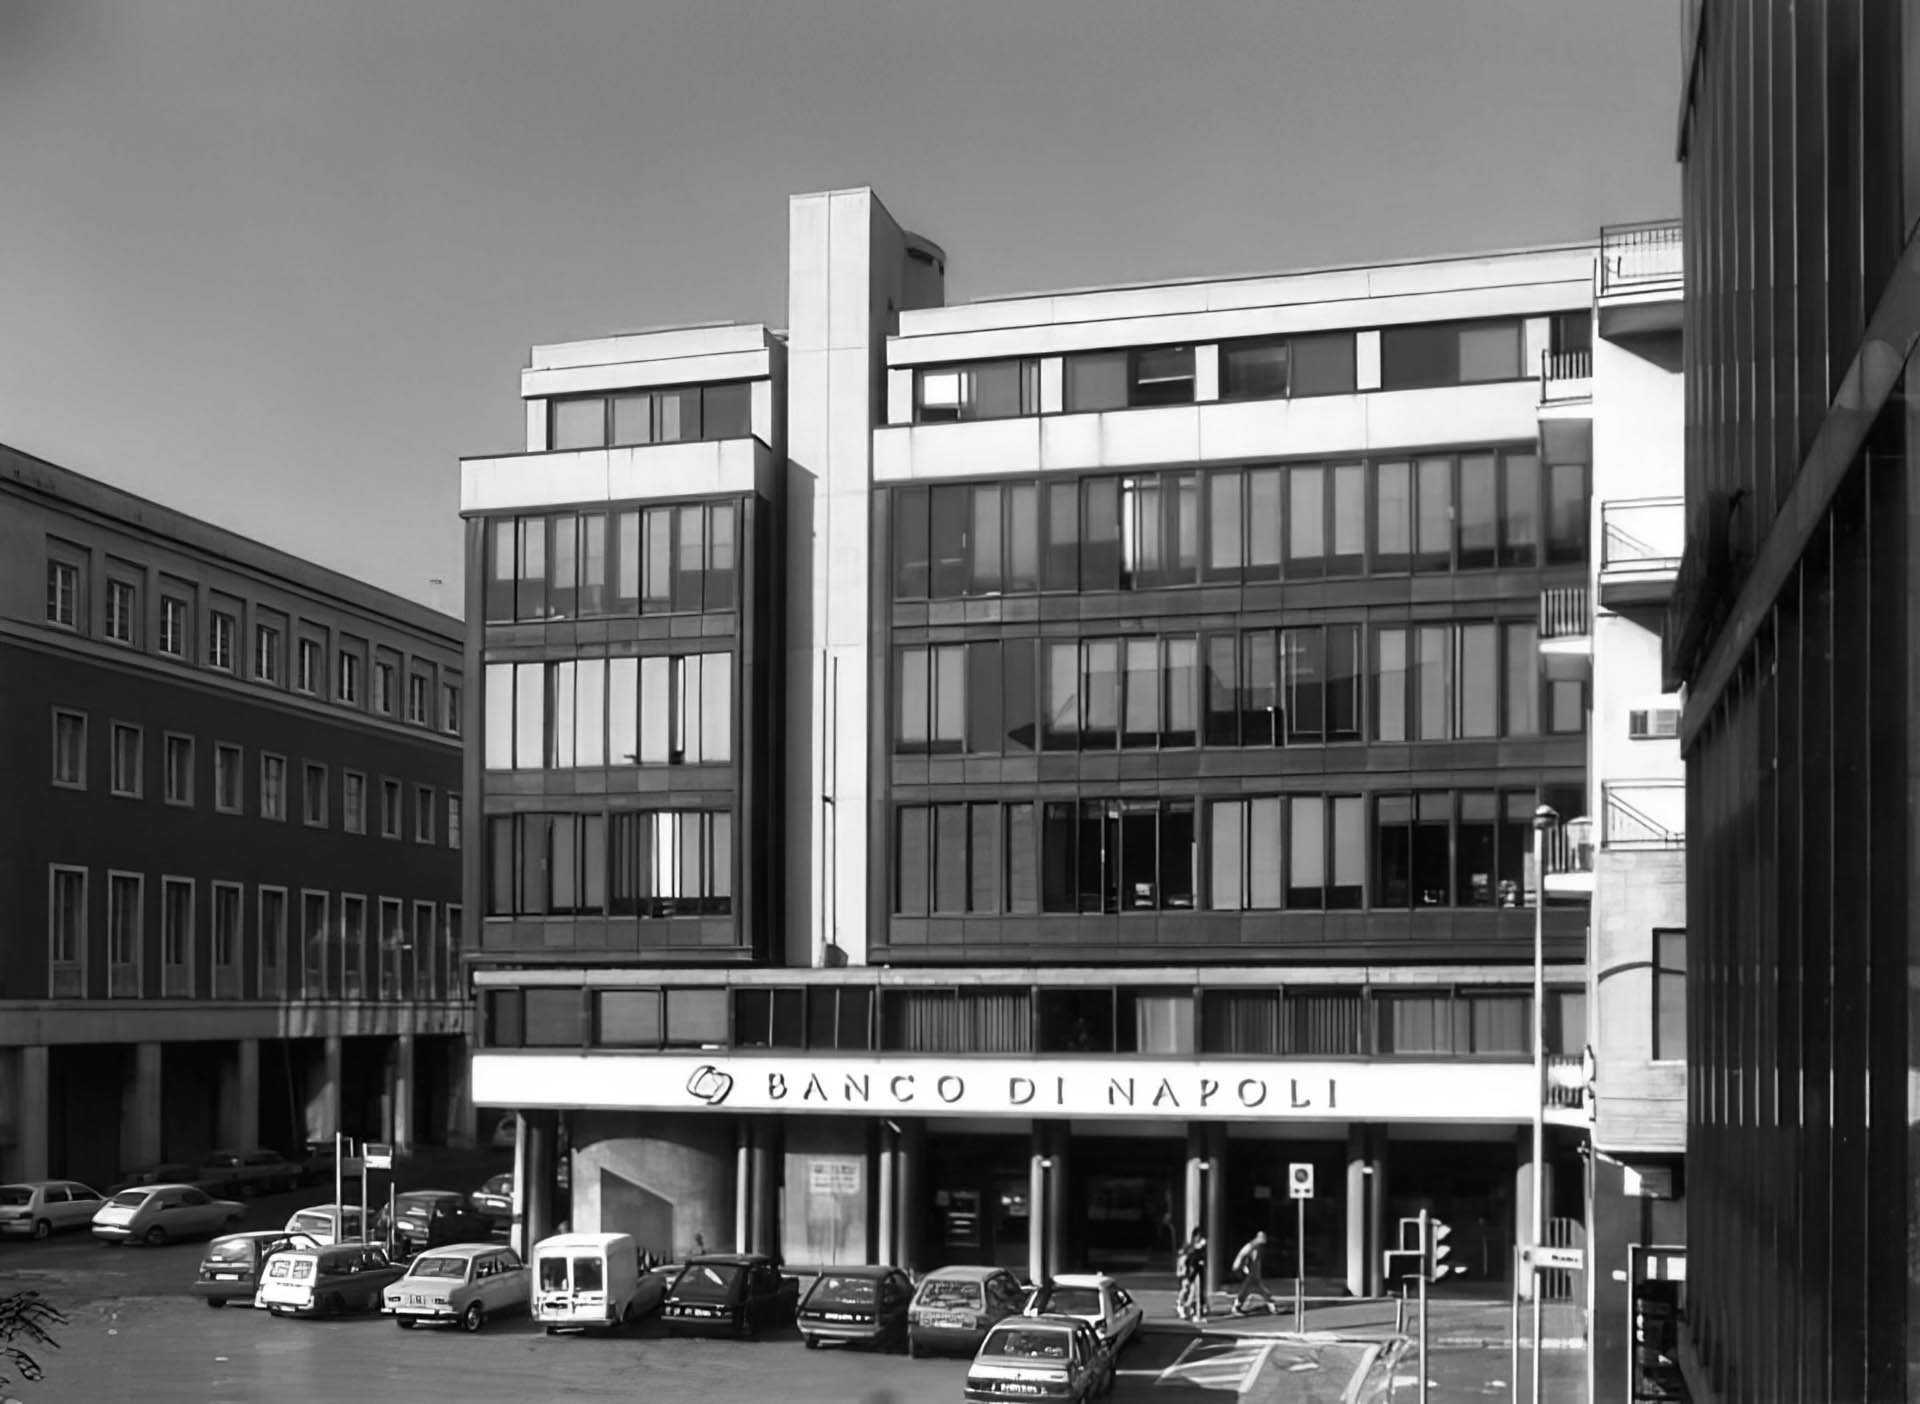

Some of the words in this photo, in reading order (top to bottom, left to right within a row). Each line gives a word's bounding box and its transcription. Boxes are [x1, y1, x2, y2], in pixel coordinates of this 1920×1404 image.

[768, 1072, 965, 1103] BANCO
[1009, 1077, 1065, 1105] DI
[1108, 1078, 1336, 1108] NAPOLI
